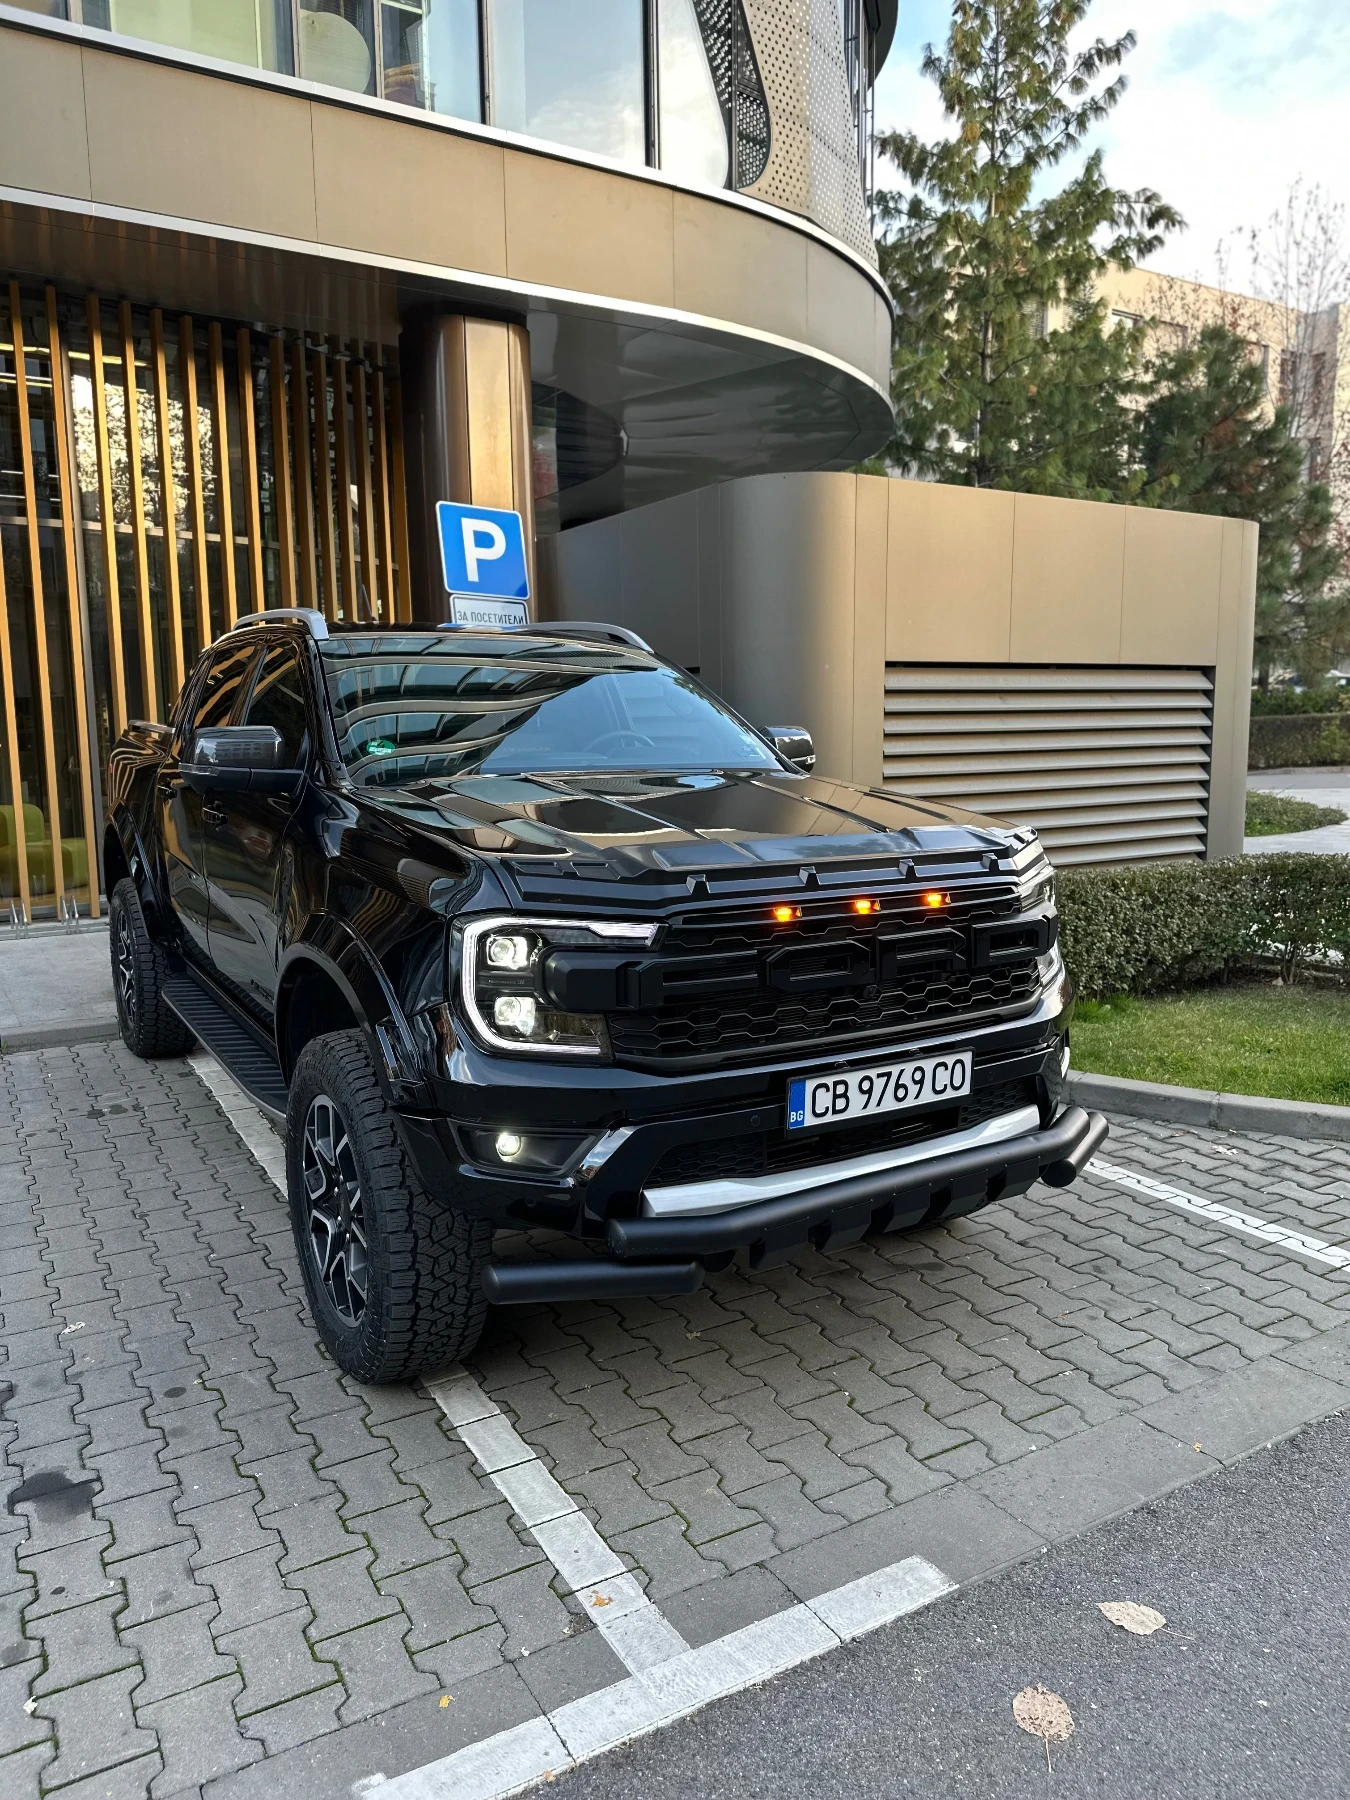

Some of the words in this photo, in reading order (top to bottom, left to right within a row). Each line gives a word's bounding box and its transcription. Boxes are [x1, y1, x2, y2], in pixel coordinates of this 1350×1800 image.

[461, 517, 507, 582] P
[457, 610, 469, 621] ЗА
[470, 611, 524, 625] ПОСЕТИТЕЛИ
[624, 914, 1055, 1009] FORD
[790, 1110, 804, 1122] BG
[811, 1079, 850, 1118] CB
[858, 1065, 926, 1110] 9769
[931, 1058, 966, 1095] CO
